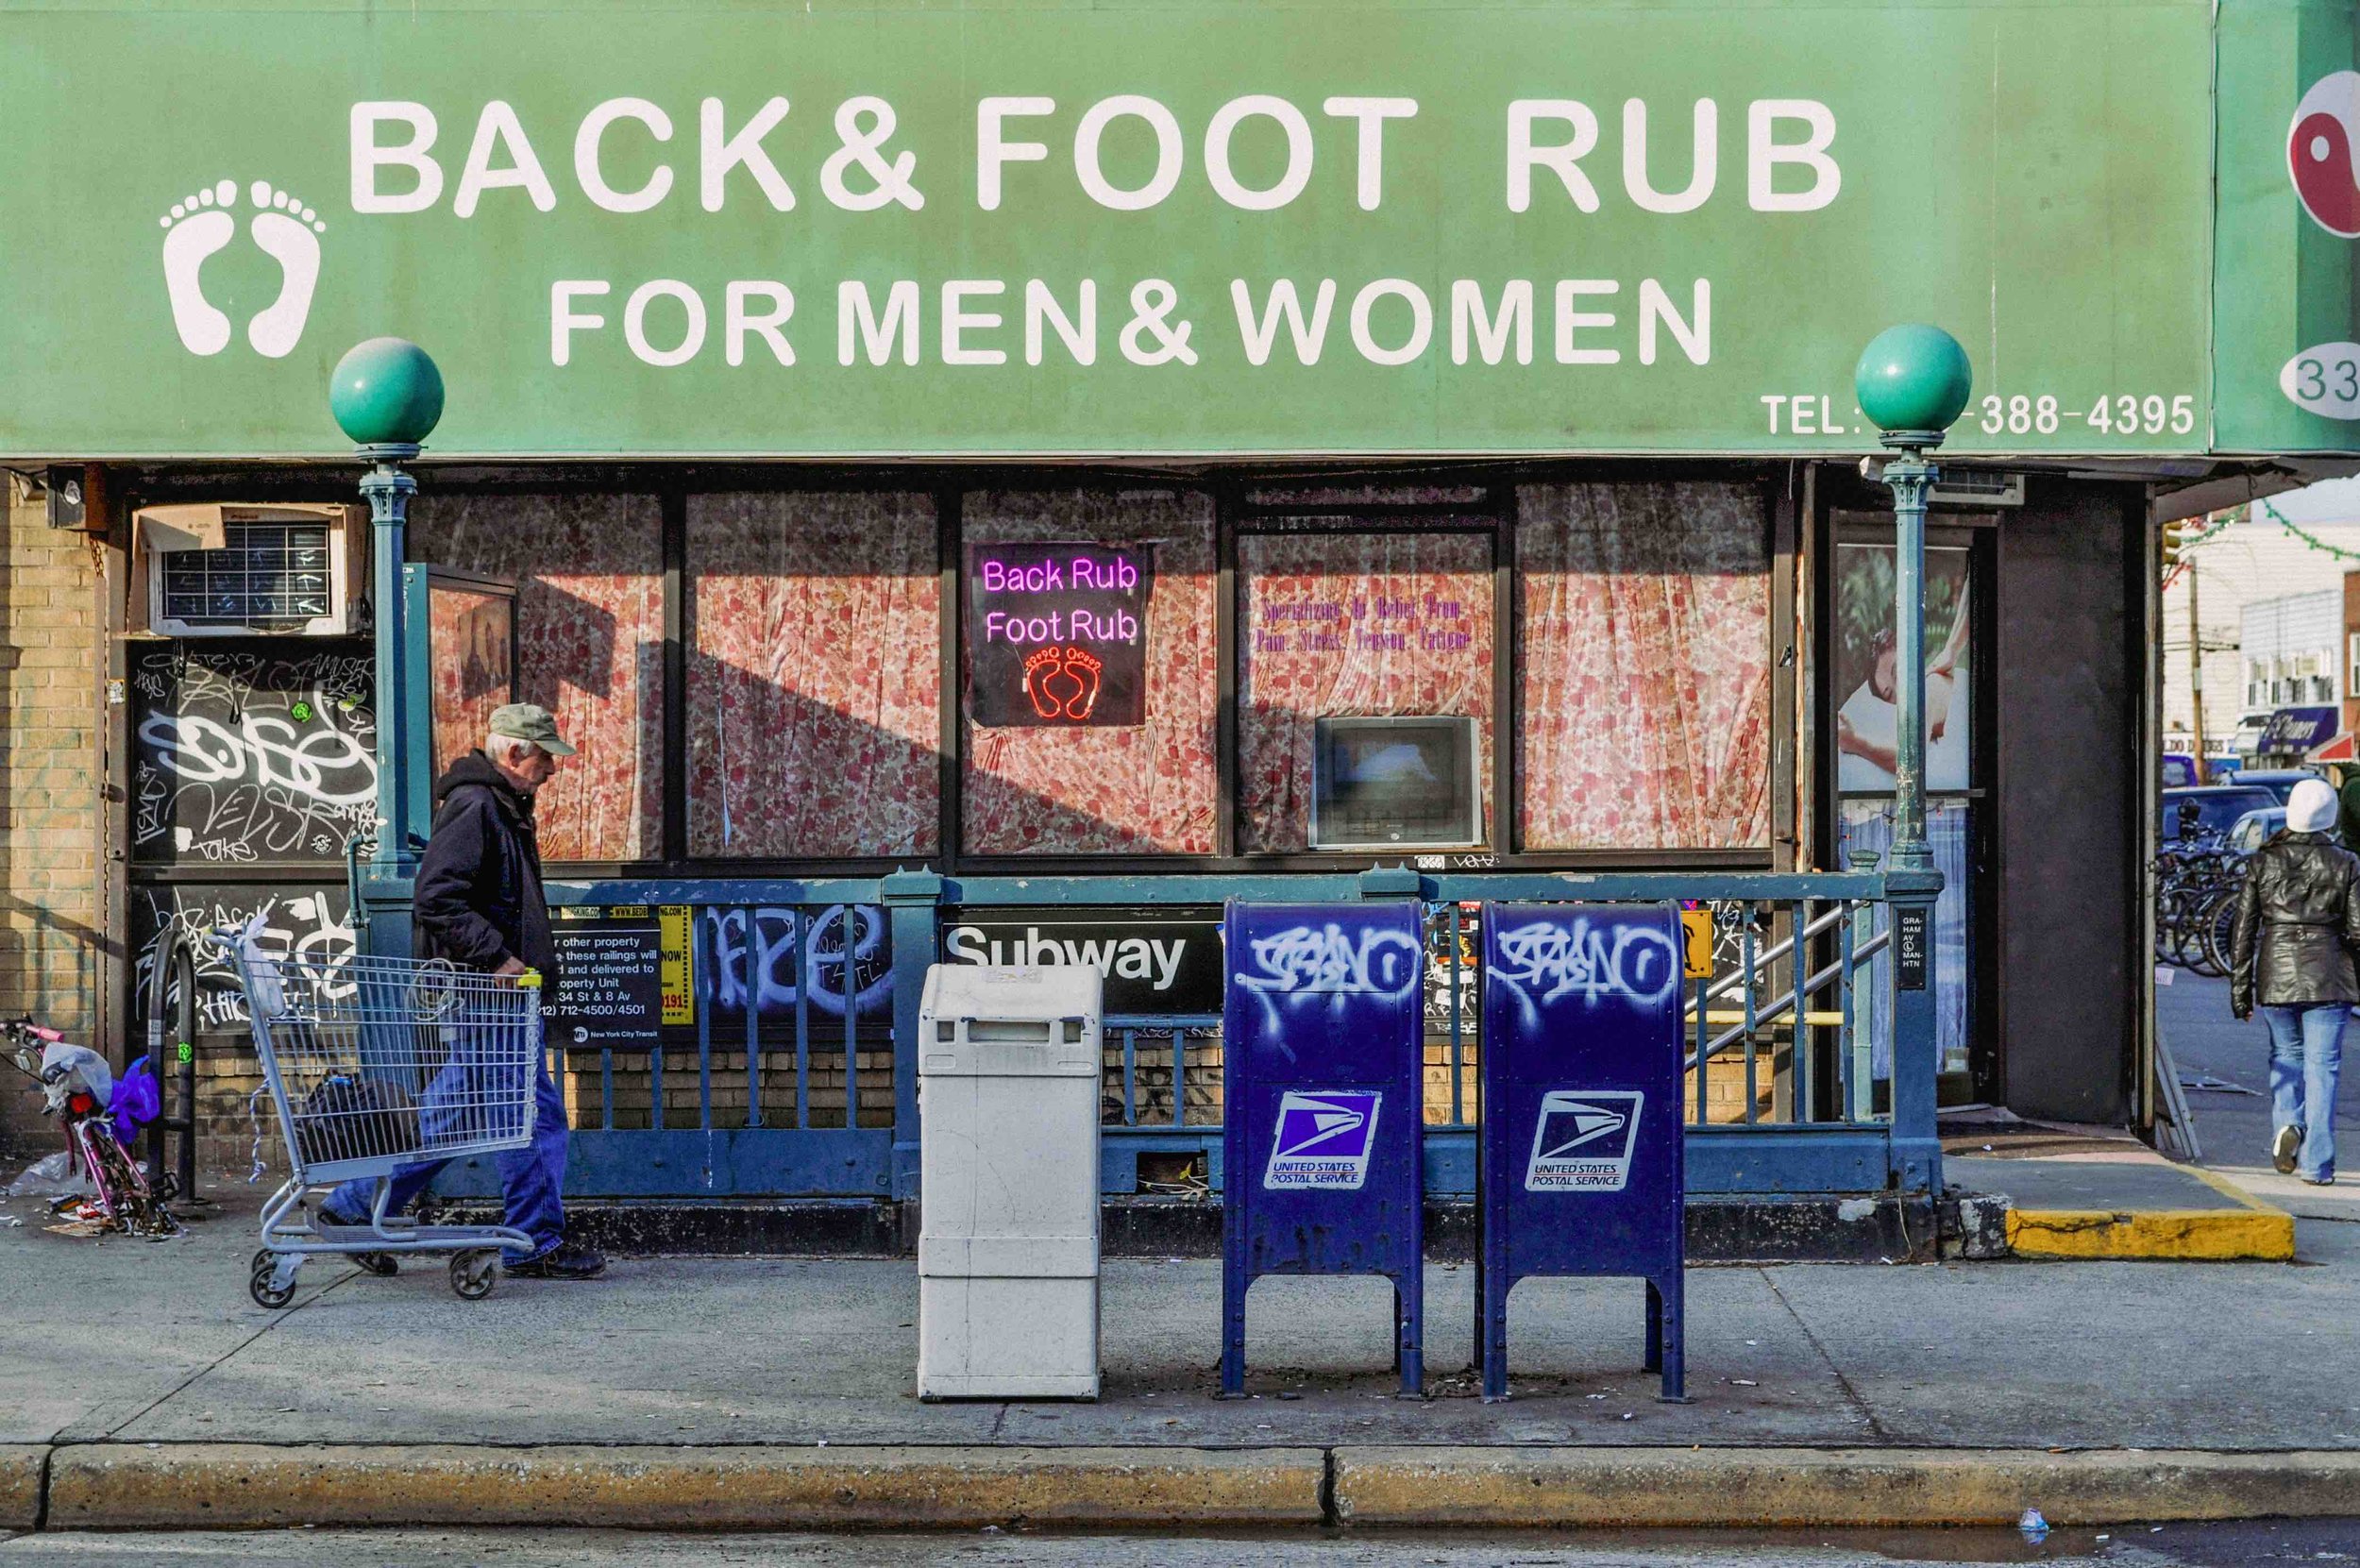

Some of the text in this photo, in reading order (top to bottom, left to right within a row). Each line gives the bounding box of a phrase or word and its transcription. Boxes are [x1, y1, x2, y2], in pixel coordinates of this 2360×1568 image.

[978, 94, 1418, 211] FOOT
[1507, 97, 1842, 213] RUB
[551, 278, 796, 366] FOR
[1962, 395, 2194, 434] -388-4395
[984, 557, 1137, 592] Back Rub
[1352, 596, 1366, 619] In
[1376, 596, 1416, 619] Relief
[1427, 595, 1460, 619] From
[986, 608, 1138, 643] Foot Rub
[563, 937, 591, 947] other
[595, 936, 640, 948] property
[566, 951, 596, 961] these
[600, 950, 636, 961] railings
[641, 950, 657, 959] will
[662, 951, 682, 962] NOW
[947, 927, 1186, 990] Subway
[568, 965, 587, 974] and
[592, 964, 639, 974] delivered
[644, 964, 654, 973] to
[598, 978, 619, 988] Unit
[559, 991, 631, 1002] 34 St & 8 Av
[560, 1004, 645, 1016] 712-4500/4501
[1273, 1162, 1356, 1172] UNITED STATES
[1535, 1164, 1617, 1173] UNITED STATES
[1272, 1173, 1357, 1184] POSTAL SERVICE
[1532, 1176, 1620, 1186] POSTAL SERVICE
